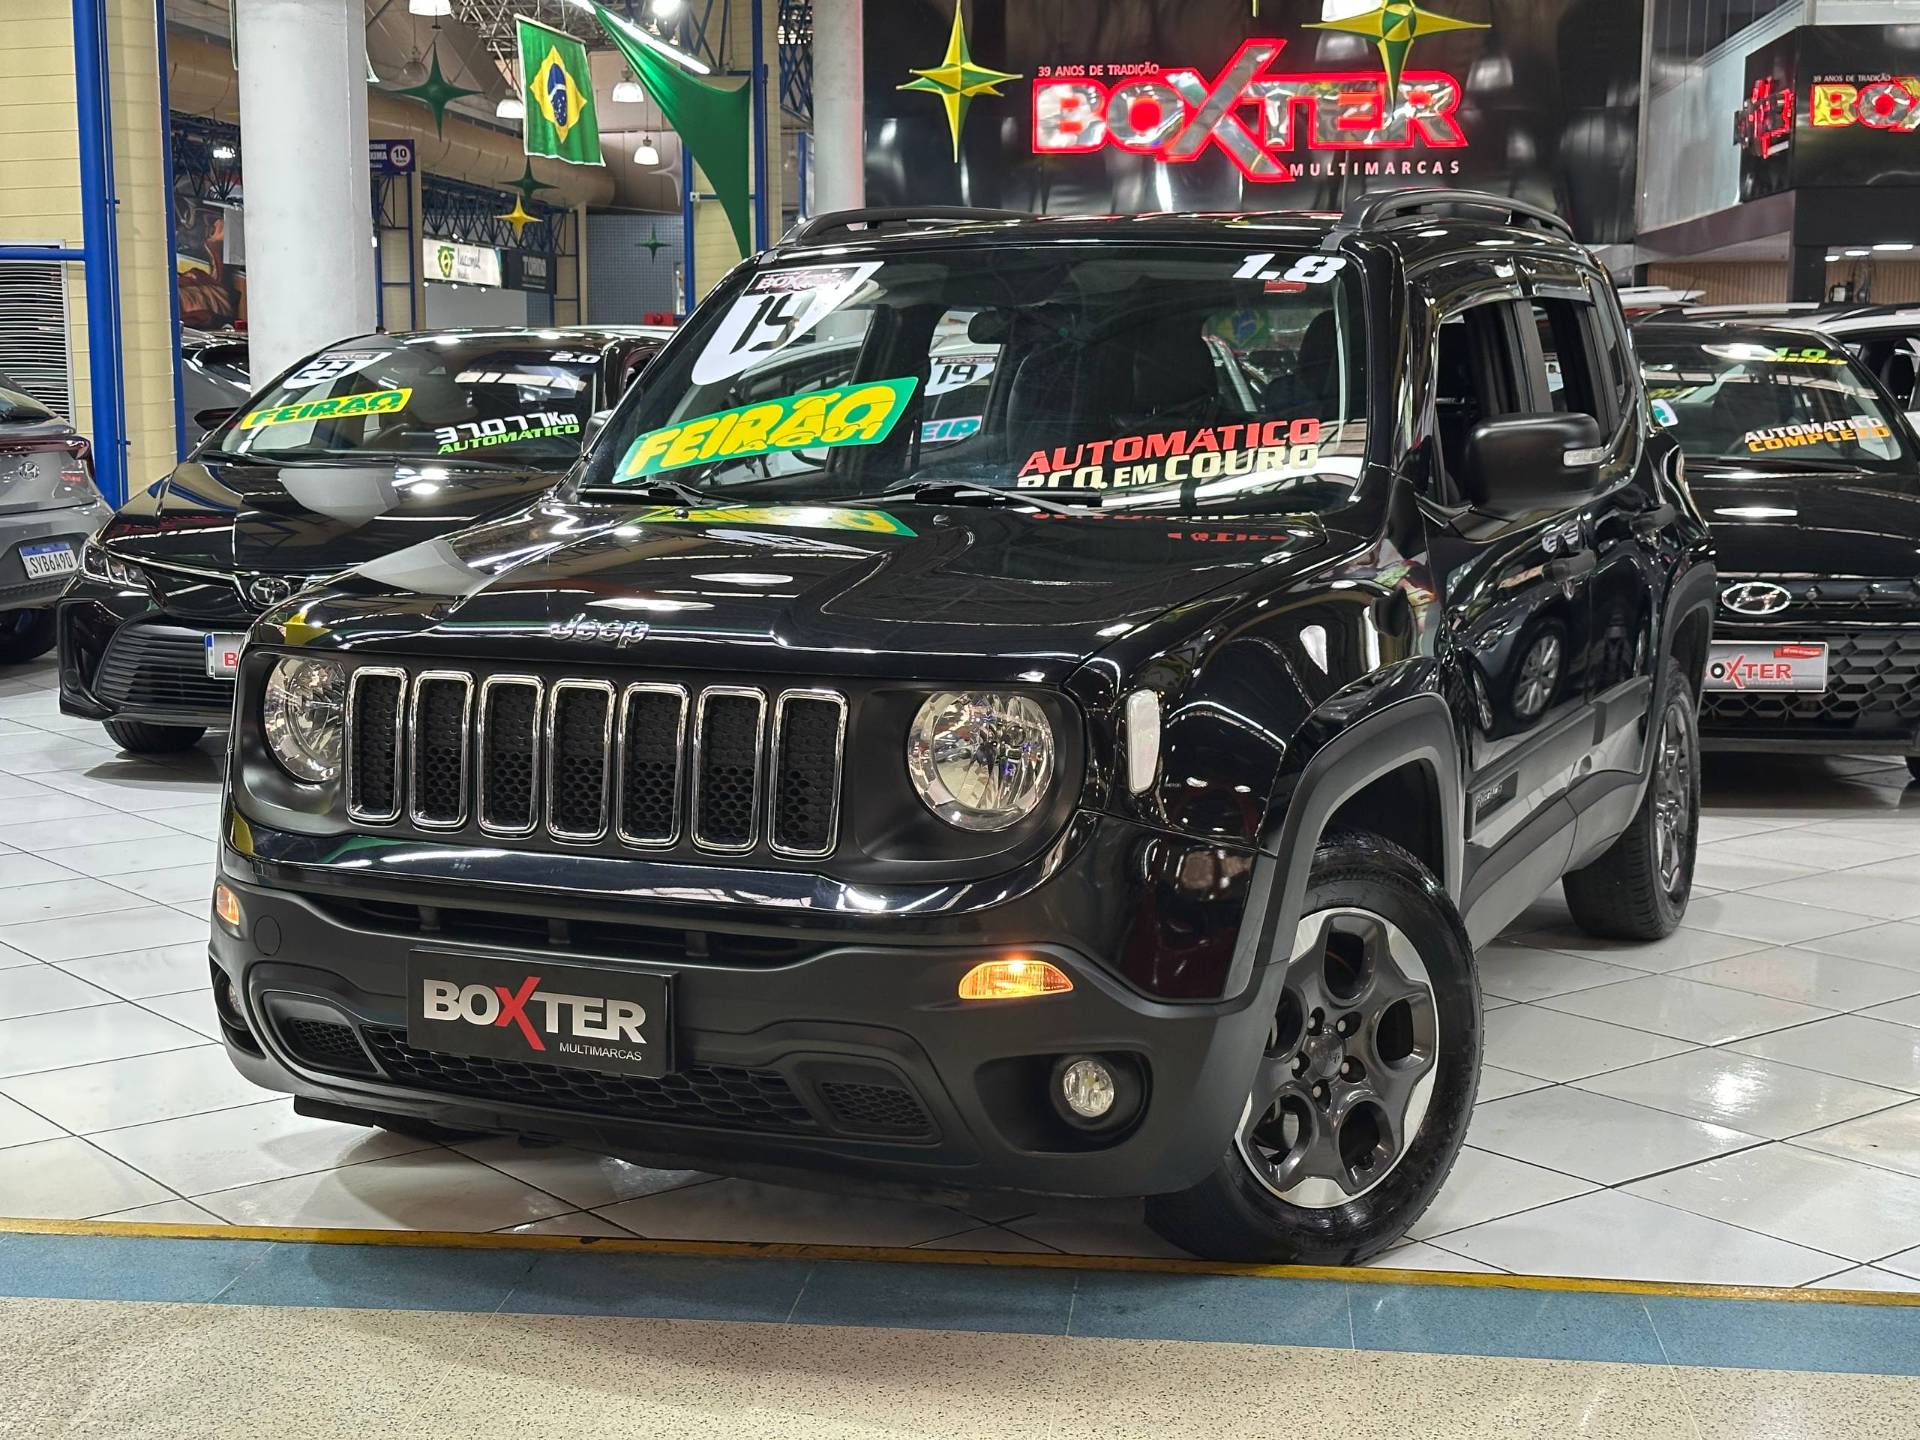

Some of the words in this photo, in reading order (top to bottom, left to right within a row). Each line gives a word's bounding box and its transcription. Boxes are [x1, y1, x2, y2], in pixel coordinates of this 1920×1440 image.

[1038, 66, 1050, 77] 39
[1055, 65, 1085, 76] ANOS
[1089, 65, 1103, 76] DE
[1107, 61, 1159, 76] TRADIÇÃO
[1824, 74, 1843, 82] ANOS
[1846, 74, 1855, 82] DE
[1858, 72, 1892, 82] TRADIÇÃO
[1032, 38, 1468, 182] BOXTER
[393, 149, 407, 159] 10
[1289, 161, 1460, 176] MULTIMARCAS
[1232, 252, 1347, 284] 1.8
[729, 293, 803, 355] 19
[549, 352, 601, 364] 2.0
[937, 364, 978, 385] 19
[625, 385, 897, 476] FEIRÃO
[1113, 467, 1157, 487] EM
[1164, 444, 1319, 482] COURO
[550, 612, 650, 649] Jeep
[1709, 654, 1793, 689] OXTER
[423, 975, 648, 1051] BOXTER
[559, 1041, 643, 1062] MULTIMARCAS
